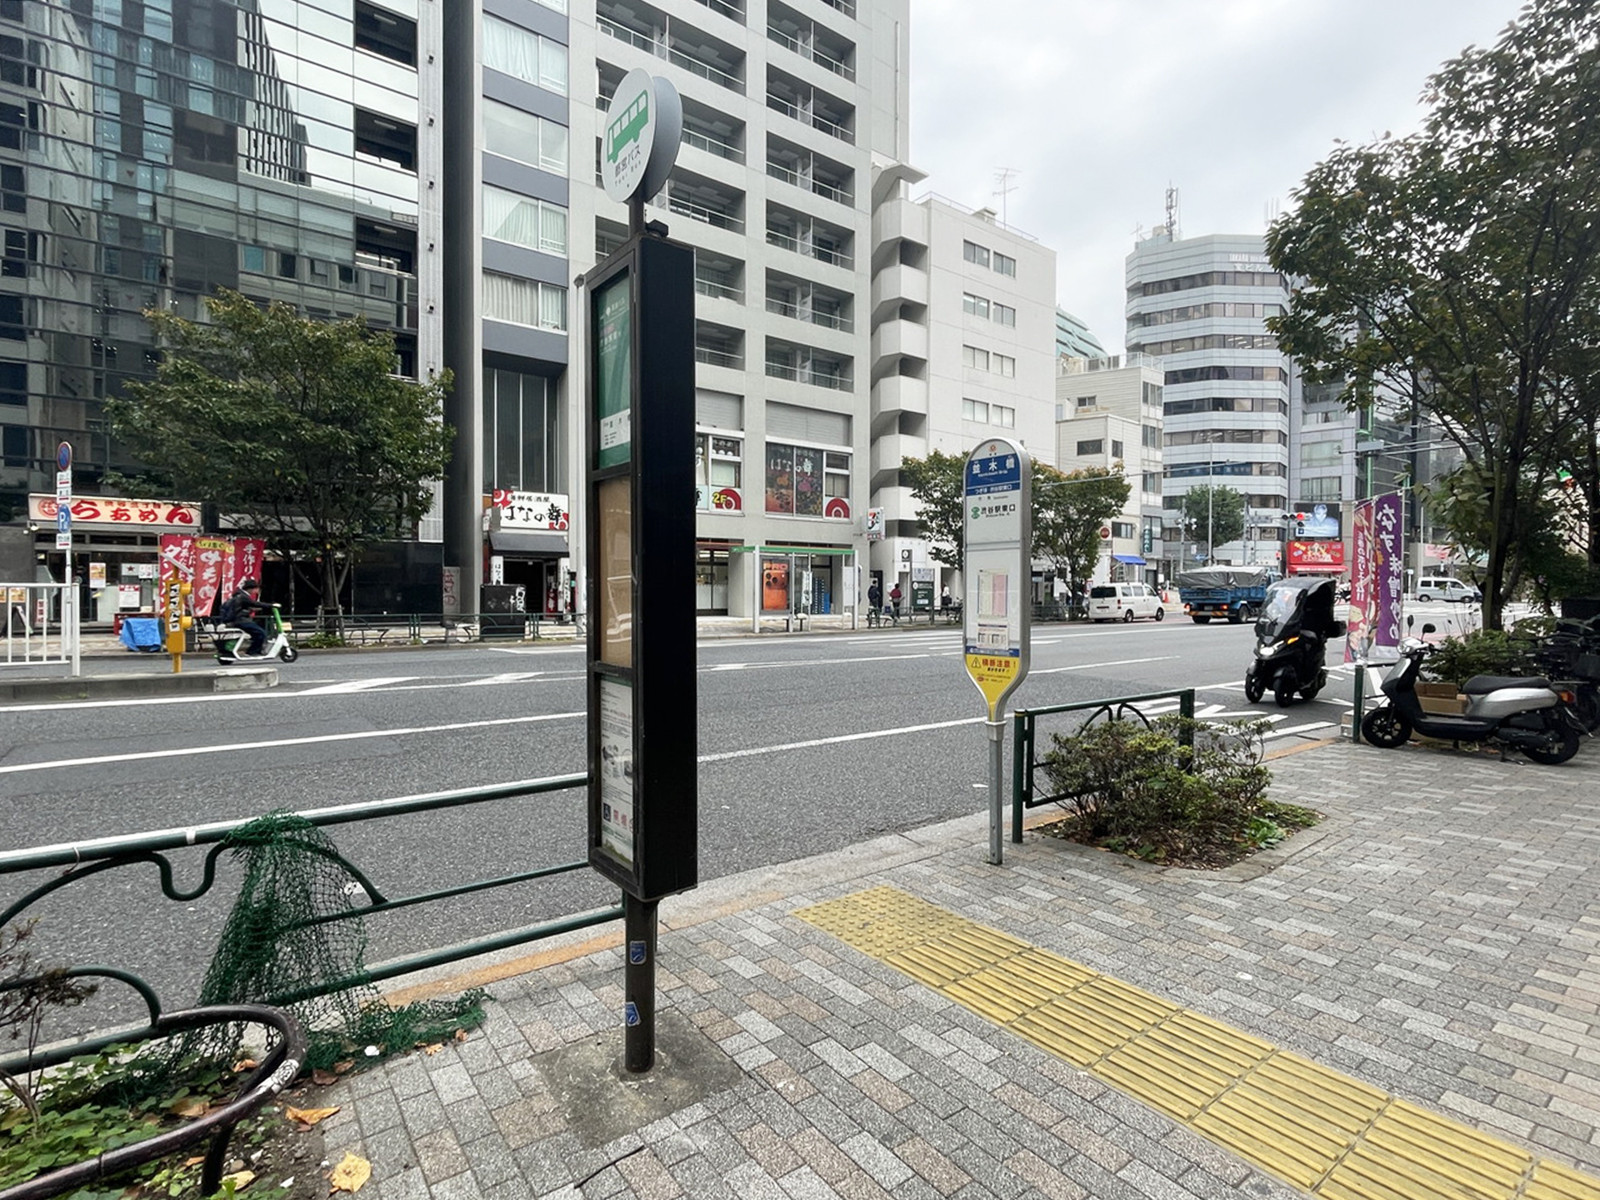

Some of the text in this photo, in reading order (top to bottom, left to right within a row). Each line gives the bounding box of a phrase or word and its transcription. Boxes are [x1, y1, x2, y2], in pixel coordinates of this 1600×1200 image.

[713, 492, 728, 504] 2F
[71, 499, 193, 525] らあめん
[981, 504, 1016, 516] 渋谷駅東口
[763, 562, 788, 571] PRO
